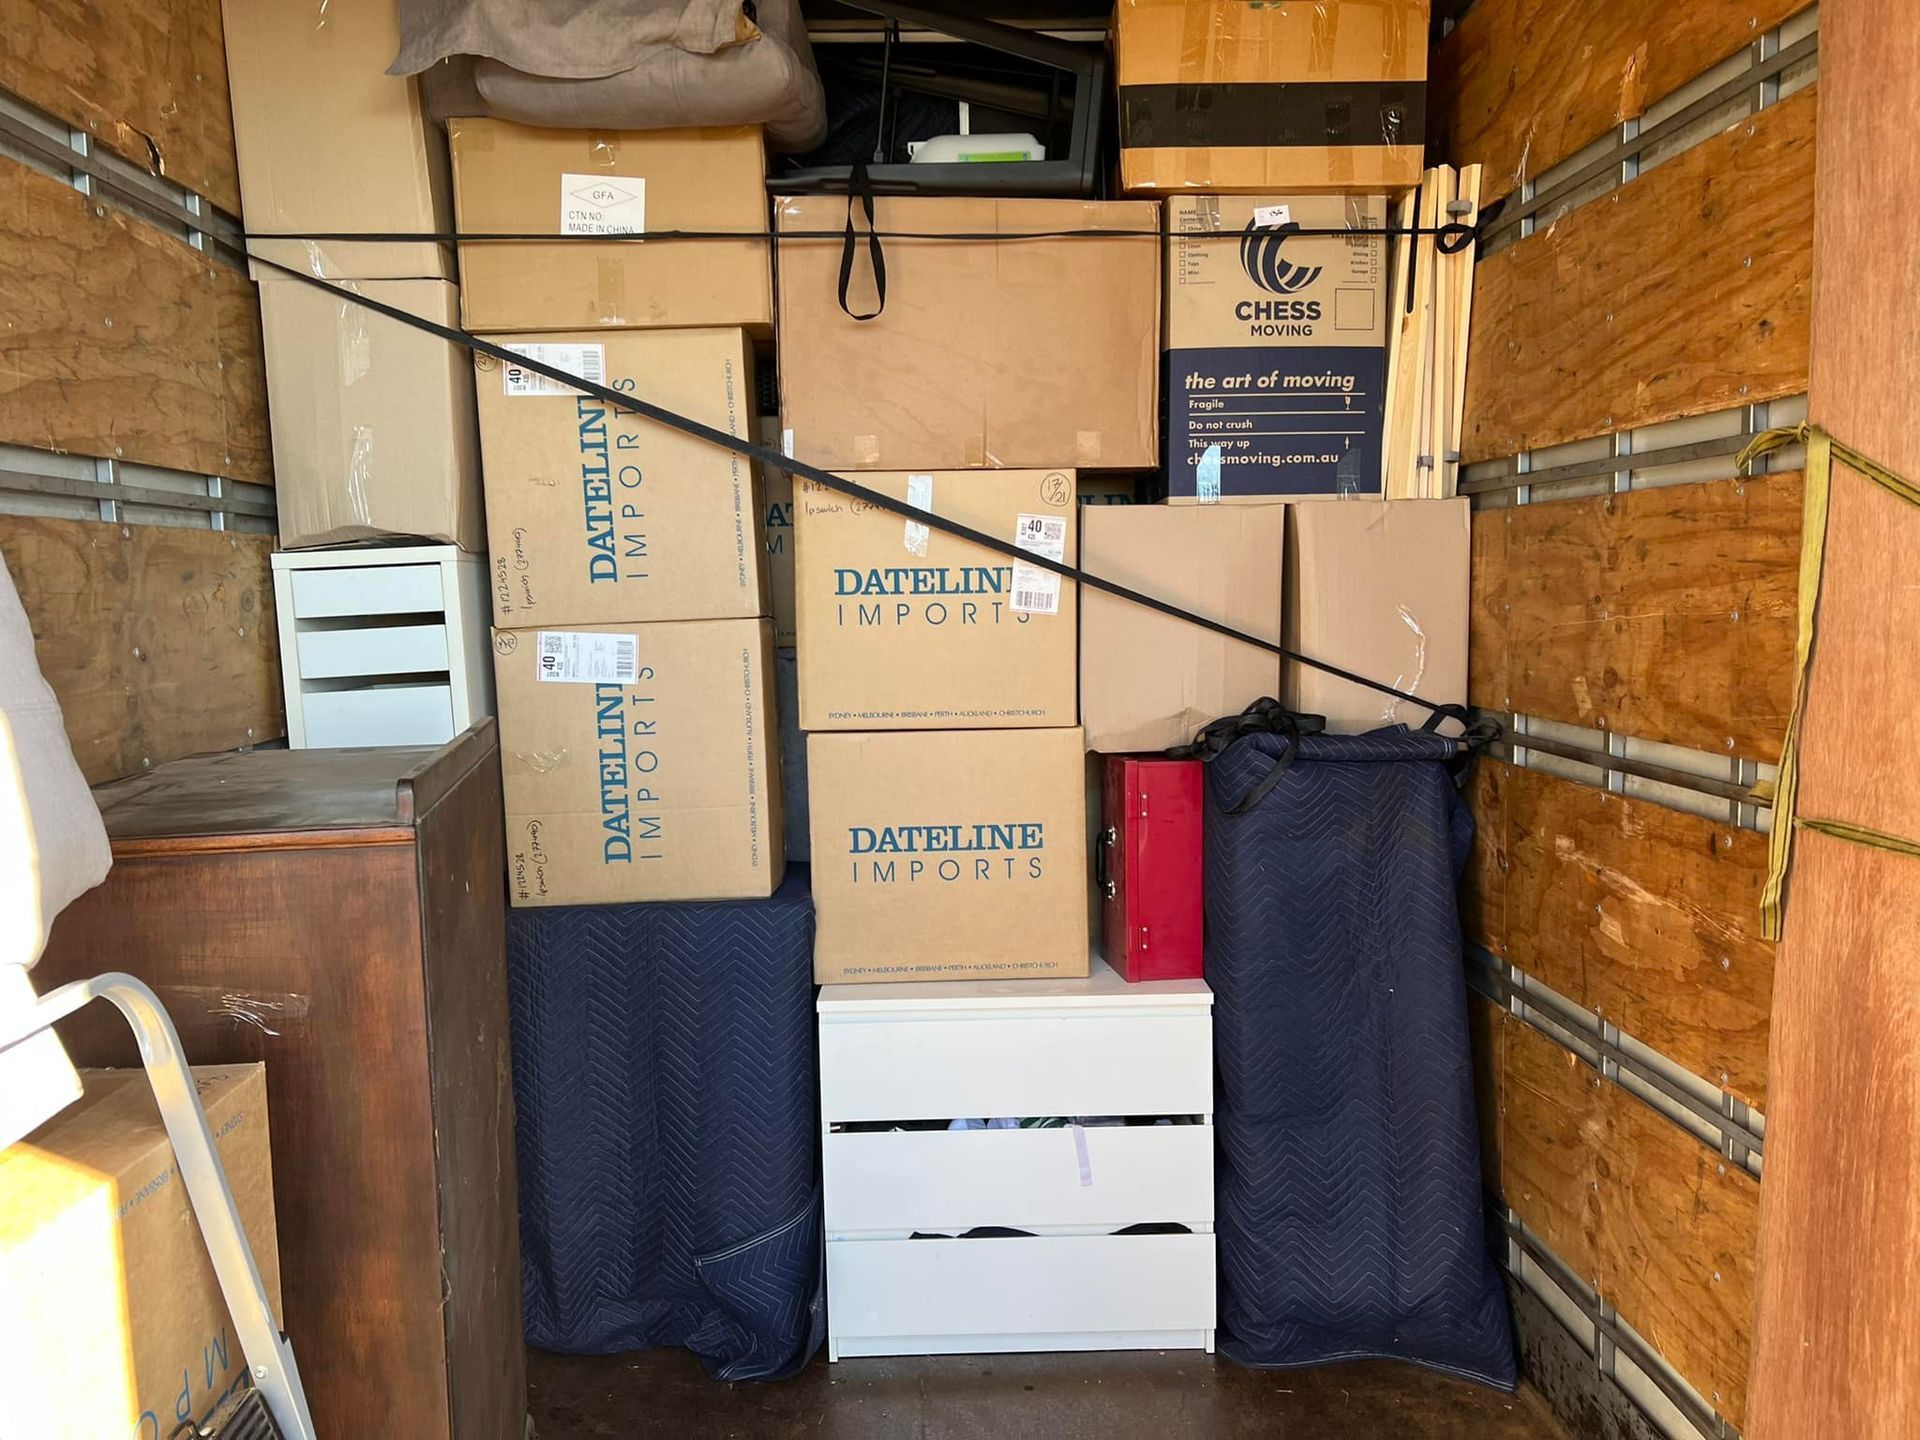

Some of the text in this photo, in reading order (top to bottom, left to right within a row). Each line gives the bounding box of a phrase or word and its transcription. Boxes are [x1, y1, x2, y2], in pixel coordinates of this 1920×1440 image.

[592, 190, 614, 200] GFA
[568, 210, 587, 220] CTN
[568, 222, 635, 235] MADE IN CHINA
[1235, 301, 1322, 321] CHESS
[1250, 325, 1313, 337] MOVING
[508, 369, 522, 384] 40
[1185, 370, 1355, 392] the art of moving
[1188, 399, 1225, 411] Fragile
[1188, 419, 1253, 430] Do not crush
[1188, 438, 1209, 449] This
[1236, 440, 1250, 450] up
[577, 395, 618, 584] DATELIN
[1027, 519, 1043, 533] 40
[834, 567, 1013, 595] DATELIN
[542, 656, 556, 671] 40
[828, 711, 852, 719] SYDNEY
[857, 711, 895, 719] MELBOURNE
[959, 710, 993, 718] AUCKLAND
[998, 710, 1046, 718] CHRISTCHURCH
[746, 742, 754, 762] PERTH
[595, 683, 632, 864] DATELIN
[749, 801, 758, 838] MELBOURNE
[848, 823, 1044, 854] DATELINE
[751, 843, 759, 868] SYDNEY
[853, 856, 1042, 883] IMPORTS
[915, 965, 943, 973] BRISBANE
[948, 964, 967, 972] PERTH
[972, 963, 1006, 971] AUCKLAND
[1012, 962, 1058, 970] CHRISTCHURCH
